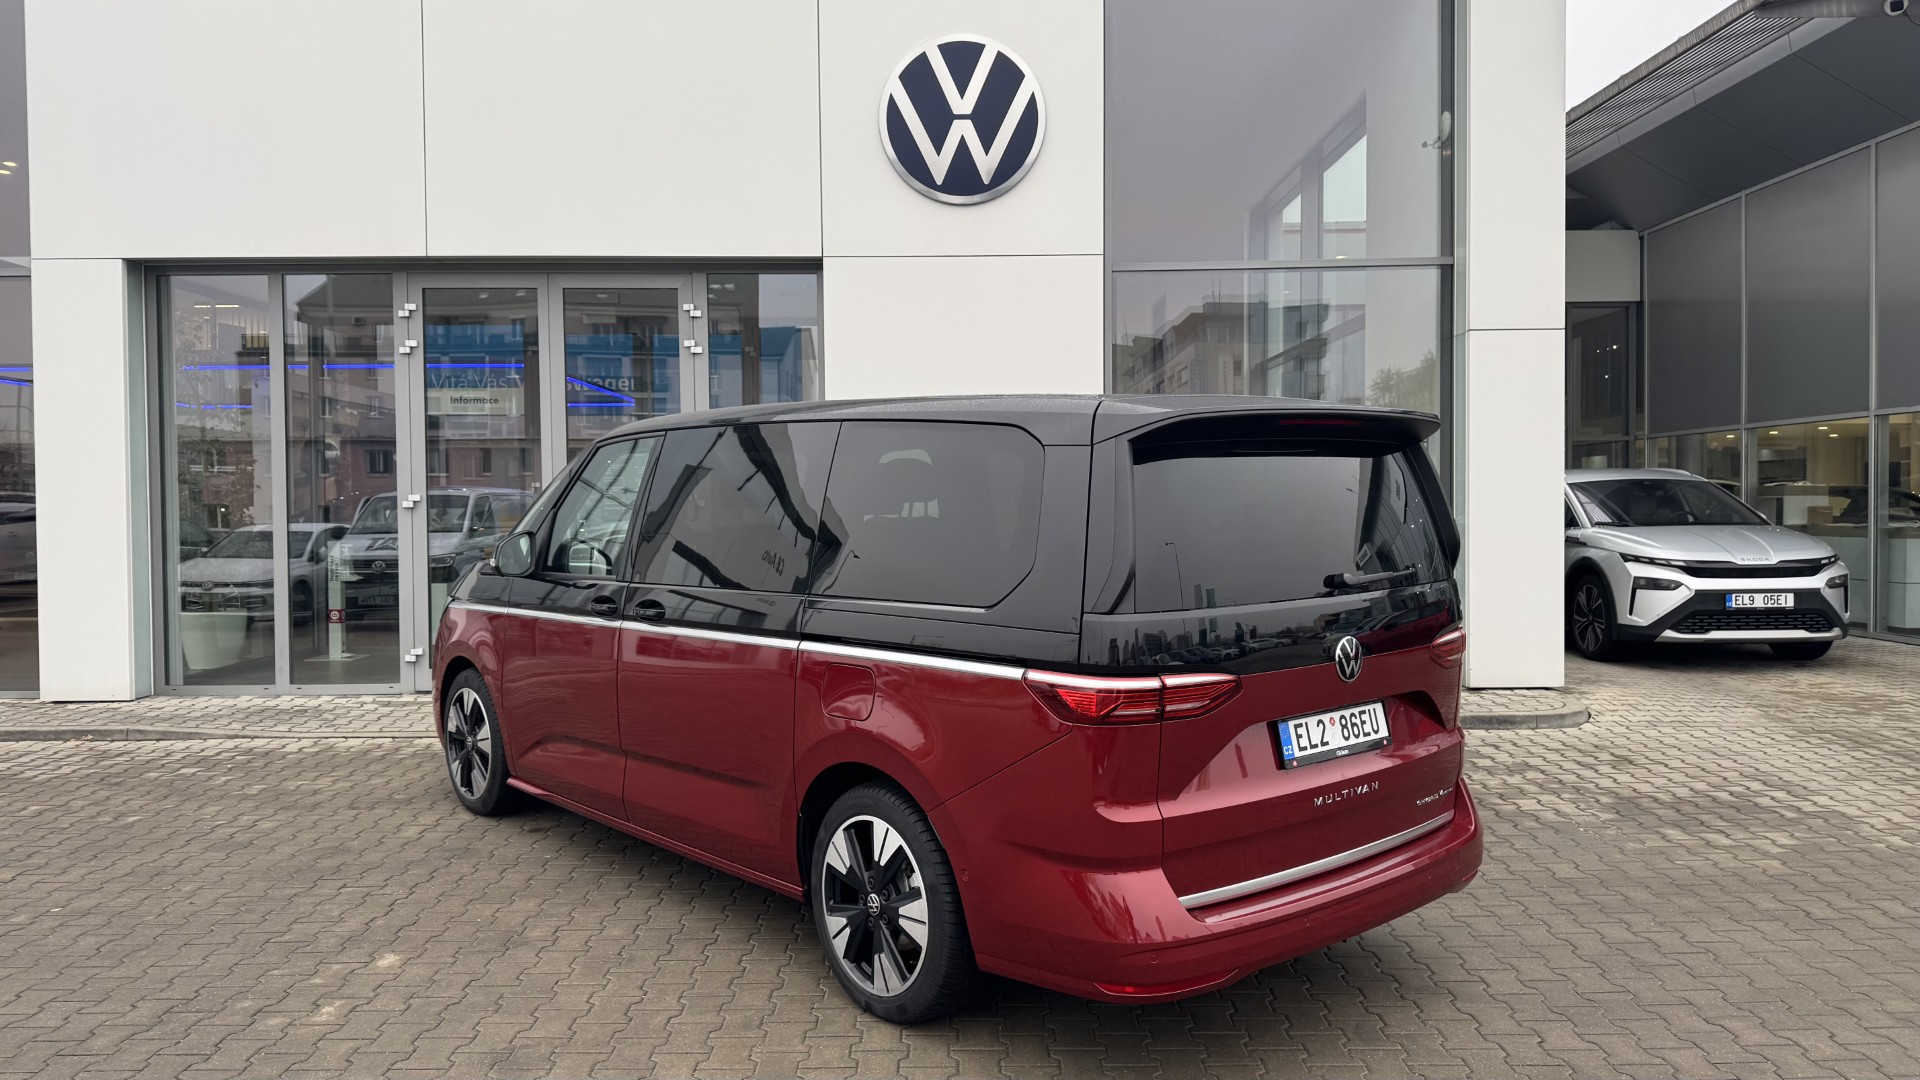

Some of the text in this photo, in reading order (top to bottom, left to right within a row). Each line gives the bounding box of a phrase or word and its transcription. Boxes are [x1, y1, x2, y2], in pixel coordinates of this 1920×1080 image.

[884, 37, 1041, 197] VW
[474, 374, 508, 390] Vás
[449, 396, 499, 405] Informace
[1734, 595, 1755, 606] EL9
[1293, 707, 1380, 752] EL2 86EU
[1283, 745, 1293, 755] CZ
[1314, 781, 1379, 807] MULTIVAN
